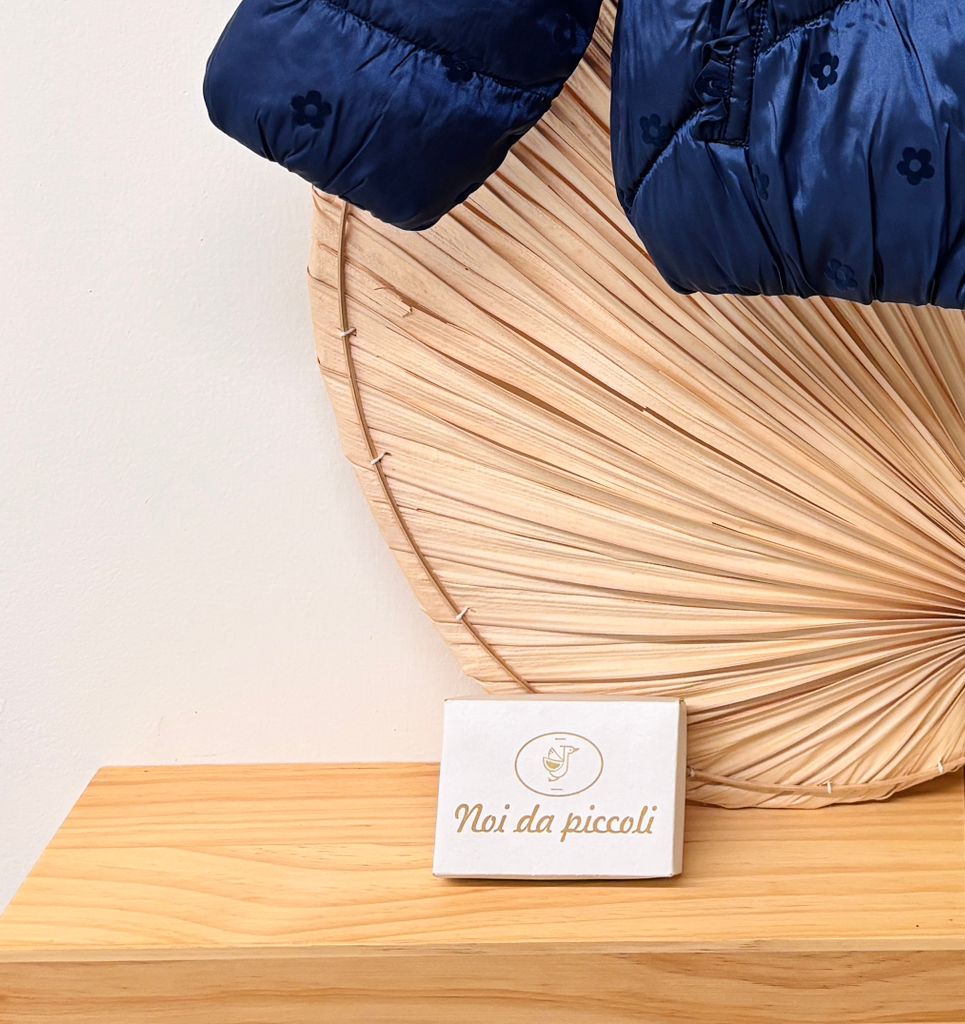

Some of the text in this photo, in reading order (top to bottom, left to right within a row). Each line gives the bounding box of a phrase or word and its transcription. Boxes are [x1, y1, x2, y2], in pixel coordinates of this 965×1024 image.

[454, 803, 658, 843] Noi da piccoli
